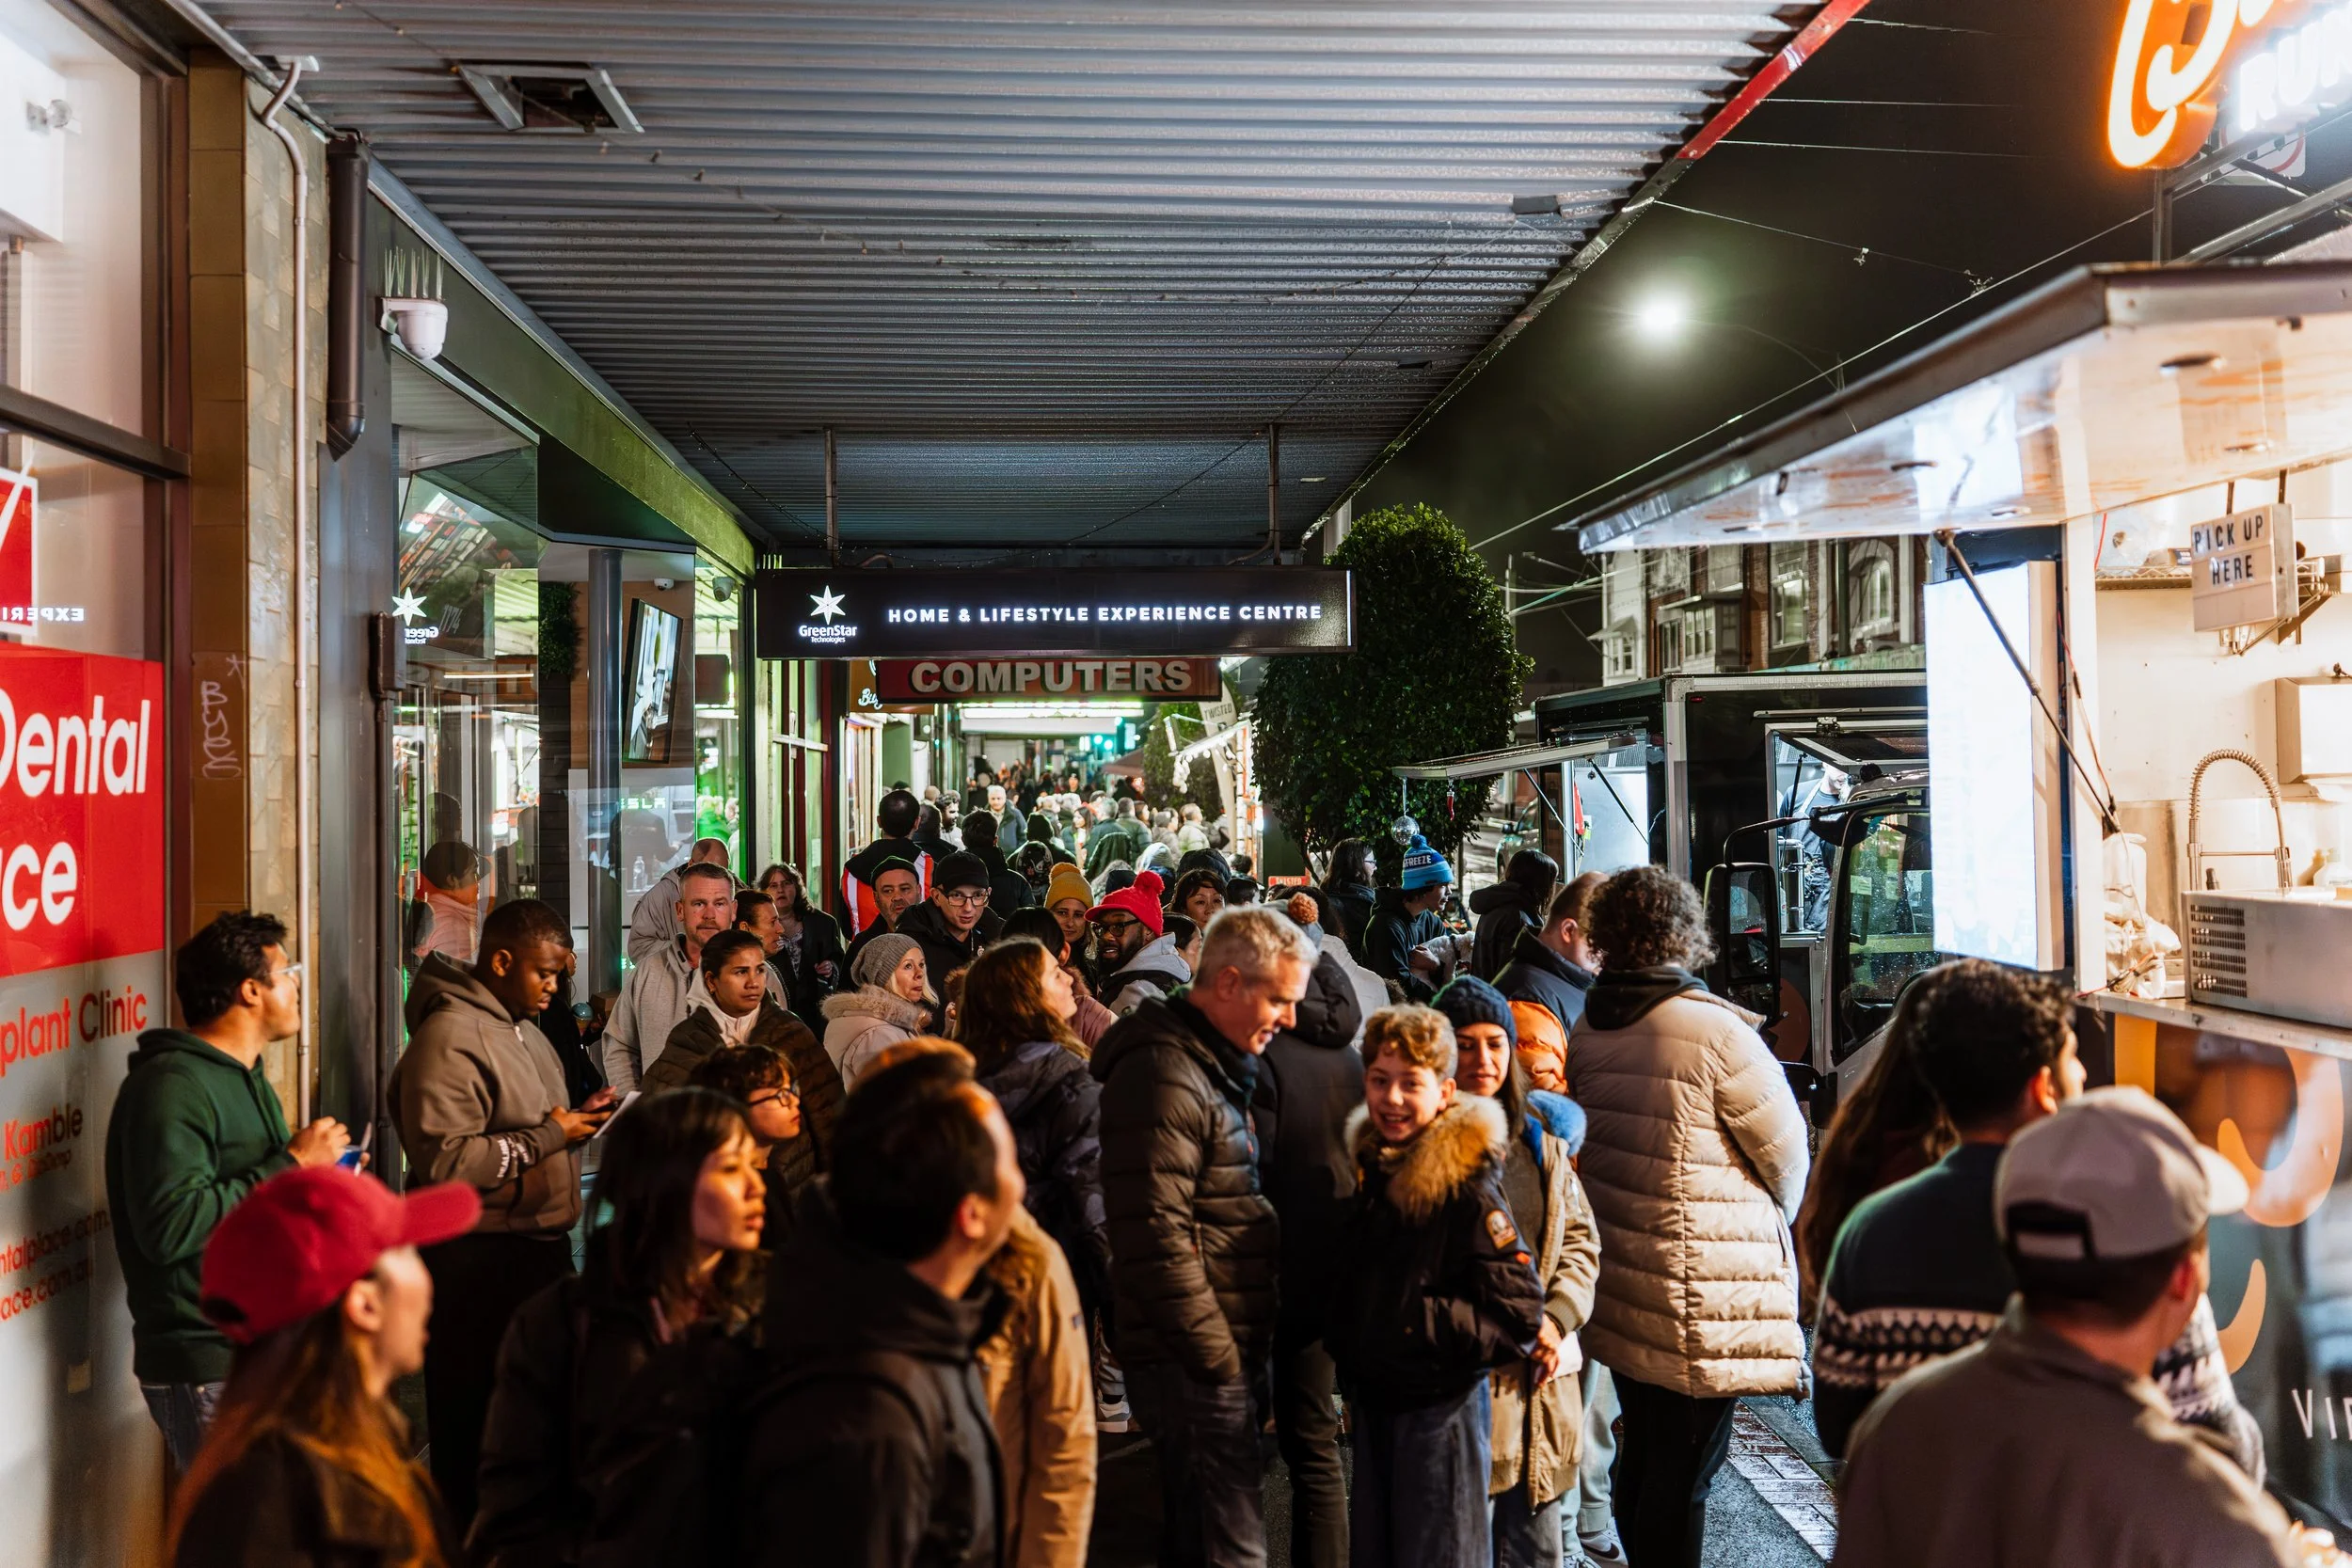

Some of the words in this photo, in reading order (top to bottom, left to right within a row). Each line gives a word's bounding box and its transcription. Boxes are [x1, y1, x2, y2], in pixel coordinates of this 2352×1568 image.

[2194, 523, 2234, 553] PICK
[2244, 515, 2264, 541] UP
[2212, 554, 2253, 585] HERE
[888, 609, 949, 622] HOME
[958, 609, 971, 622] &
[979, 608, 1089, 622] LIFESTYLE
[1097, 606, 1231, 621] EXPERIENCE
[1239, 605, 1321, 619] CENTRE
[799, 625, 858, 637] GreenStar
[811, 636, 846, 644] Technologies
[911, 660, 1192, 693] COMPUTERS
[1204, 703, 1232, 719] TWISTED
[78, 985, 148, 1043] Clinic
[4, 1103, 83, 1163] Kamble
